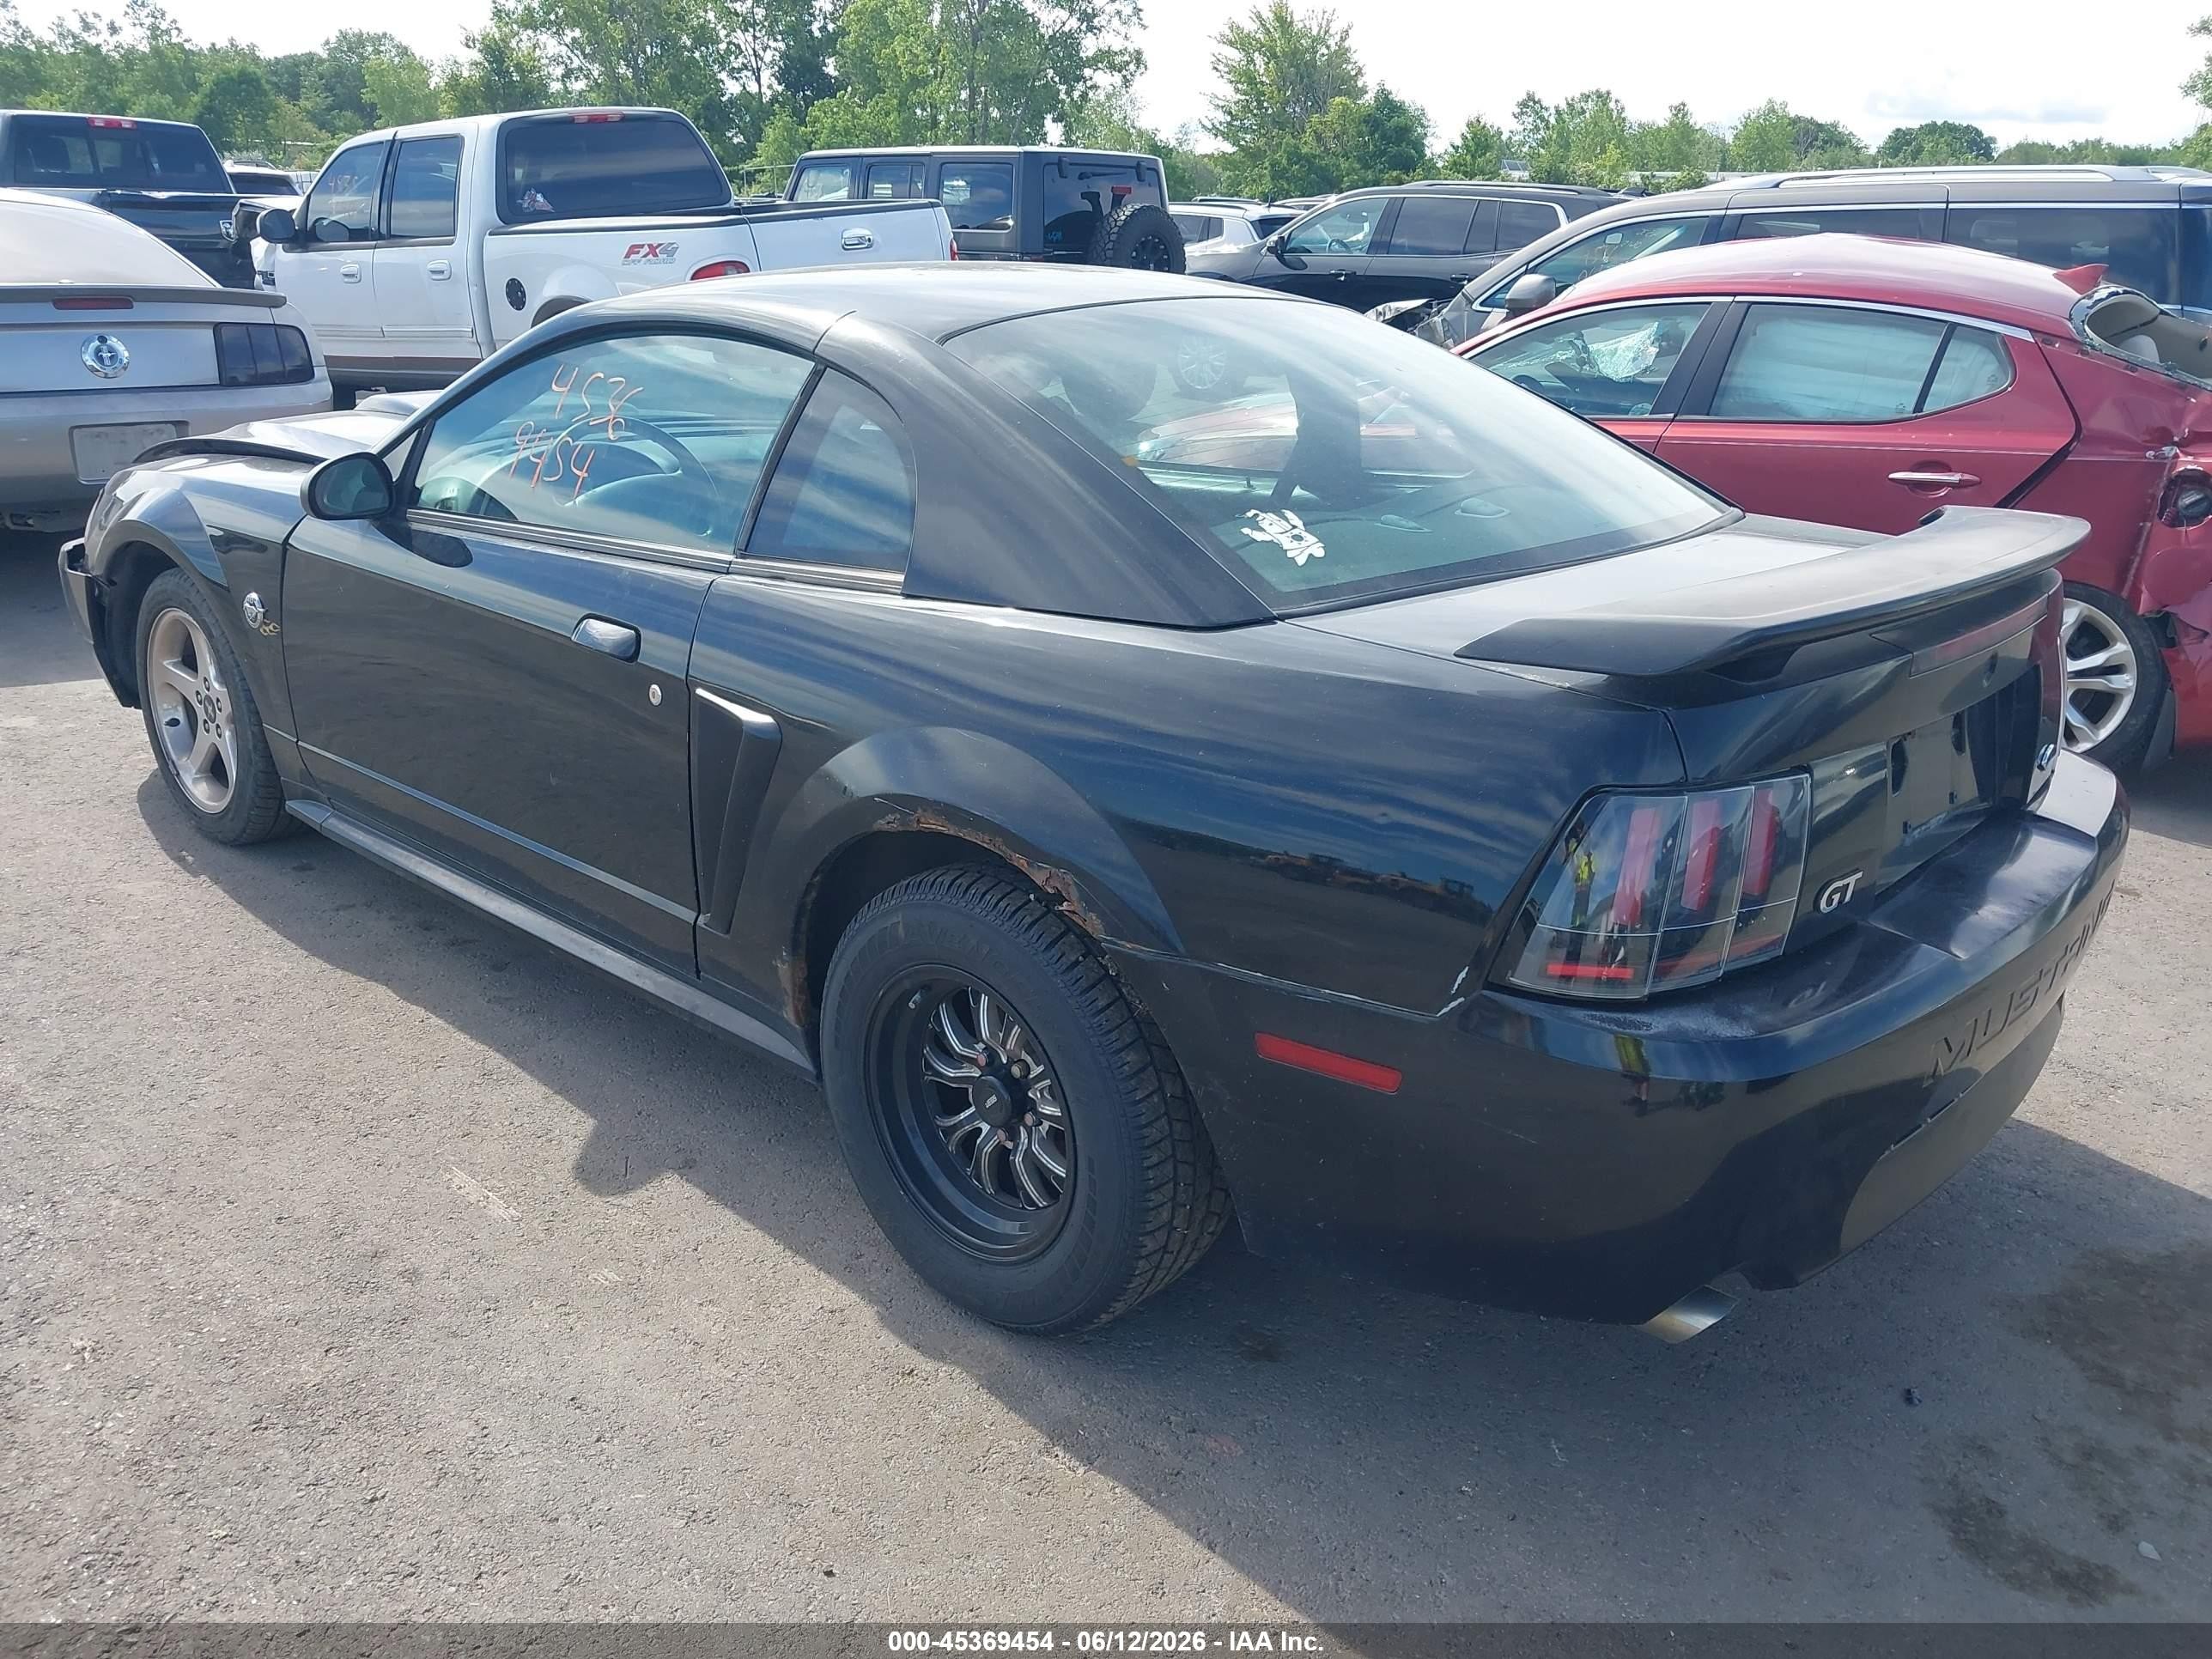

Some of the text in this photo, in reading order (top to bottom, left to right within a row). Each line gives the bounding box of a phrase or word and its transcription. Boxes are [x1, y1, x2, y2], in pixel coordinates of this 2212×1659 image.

[623, 241, 679, 258] FX4
[509, 421, 595, 501] 9454
[1820, 871, 1863, 914] GT
